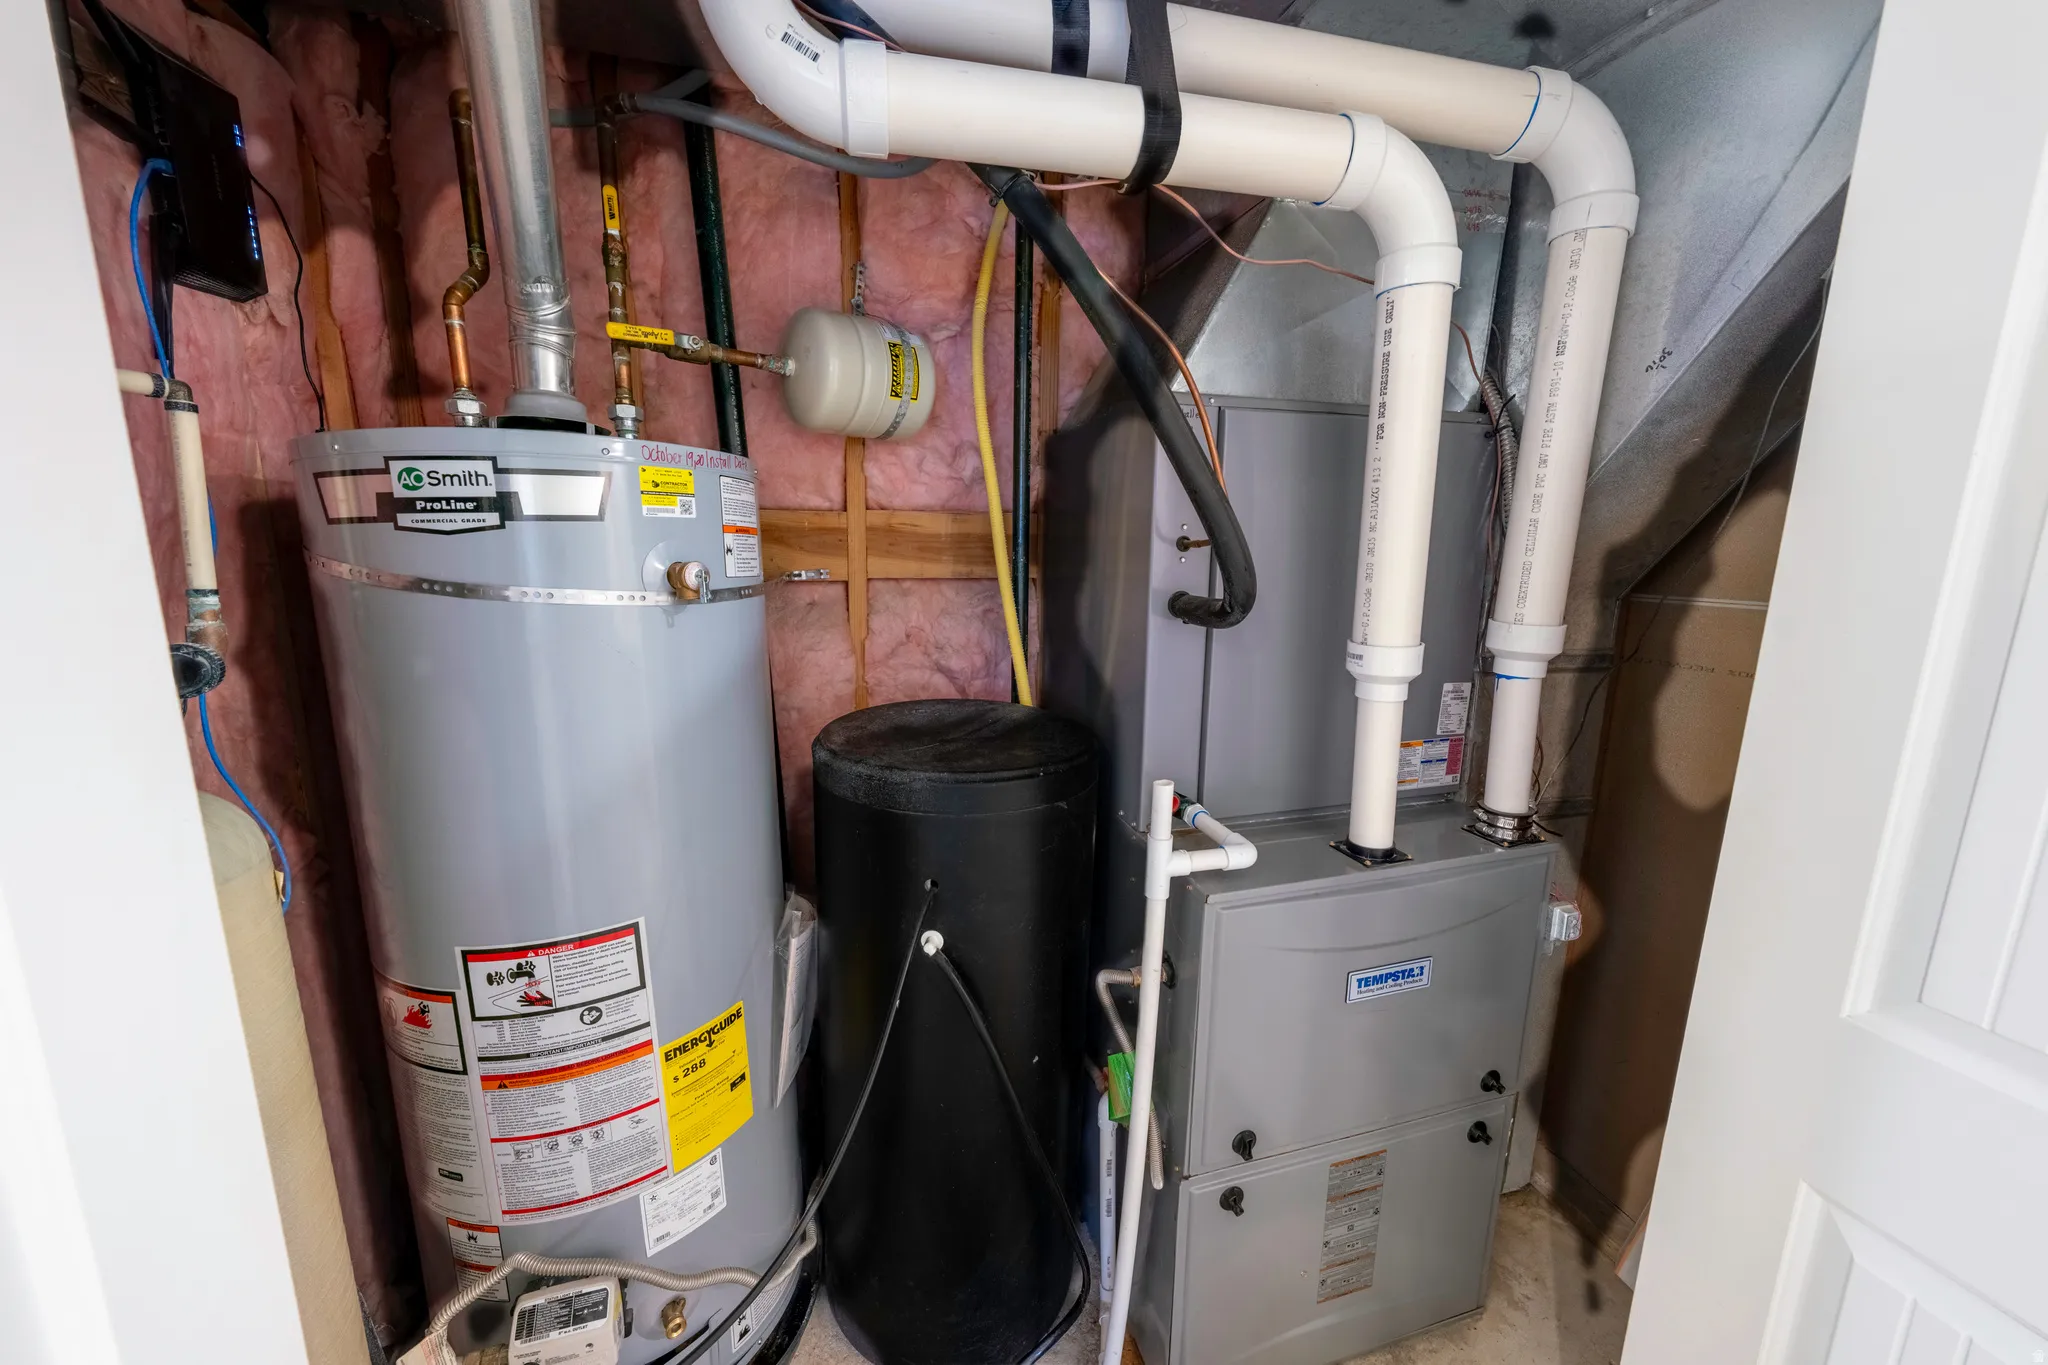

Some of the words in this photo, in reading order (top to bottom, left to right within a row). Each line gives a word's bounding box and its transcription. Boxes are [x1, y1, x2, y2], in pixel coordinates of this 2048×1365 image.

[1383, 327, 1393, 348] USE
[1377, 351, 1391, 420] NON-PRESSURE
[1545, 402, 1558, 424] ASTM
[1541, 428, 1554, 449] PIPE
[641, 444, 682, 464] October
[705, 450, 731, 469] Install
[734, 455, 748, 471] Date
[427, 470, 489, 487] Smith
[1535, 473, 1547, 488] PVC
[416, 500, 475, 511] ProLine
[1531, 493, 1543, 513] CORE
[1525, 517, 1539, 557] CELLULAR
[538, 944, 574, 956] DANGER
[1385, 981, 1403, 990] Cooling
[1403, 977, 1423, 986] Products
[682, 1058, 707, 1078] 288
